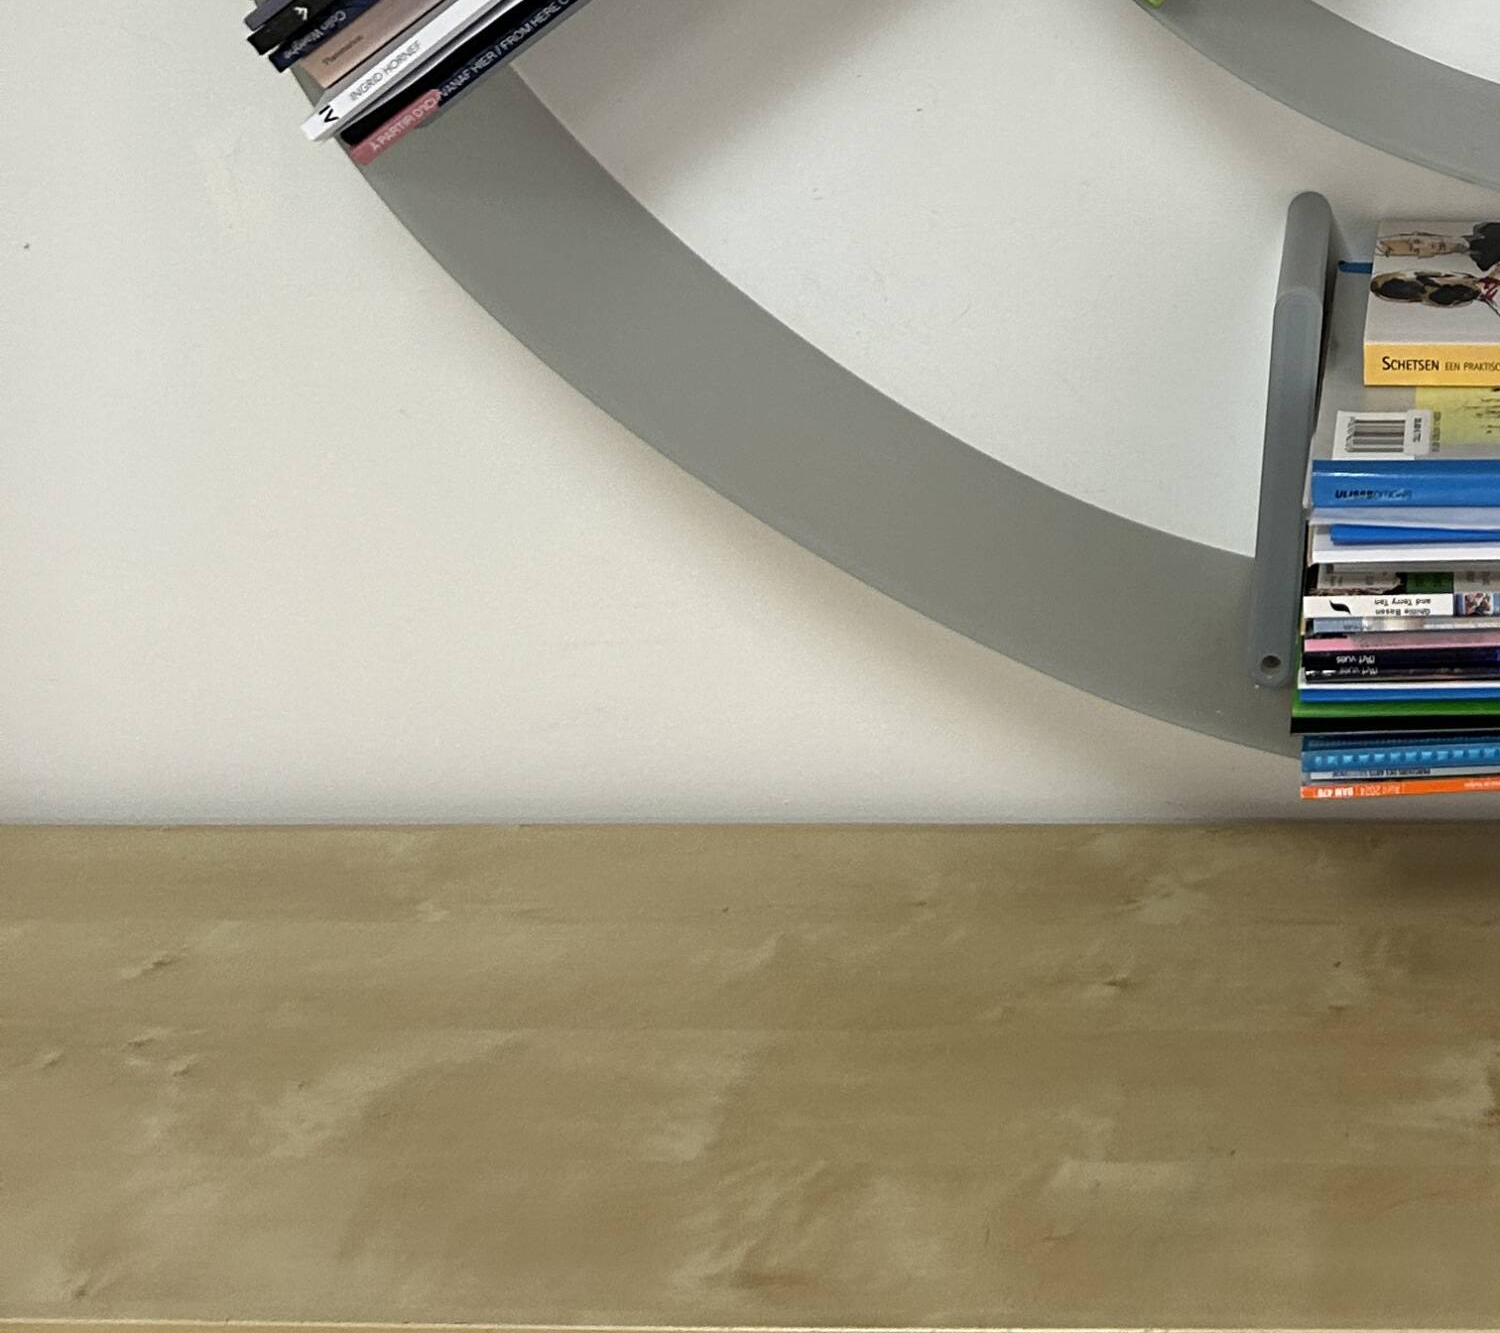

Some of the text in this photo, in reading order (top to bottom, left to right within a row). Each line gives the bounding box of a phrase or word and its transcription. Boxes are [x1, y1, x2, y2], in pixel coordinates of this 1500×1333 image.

[317, 6, 348, 35] Colin
[347, 68, 386, 103] INGRID
[374, 110, 417, 148] PARTIR
[471, 48, 500, 74] HIER
[499, 20, 535, 52] FROM
[529, 0, 561, 29] HERE
[1381, 355, 1440, 372] SCHETSEN
[1444, 359, 1460, 371] EEN
[1374, 597, 1430, 607] and Terry Tan
